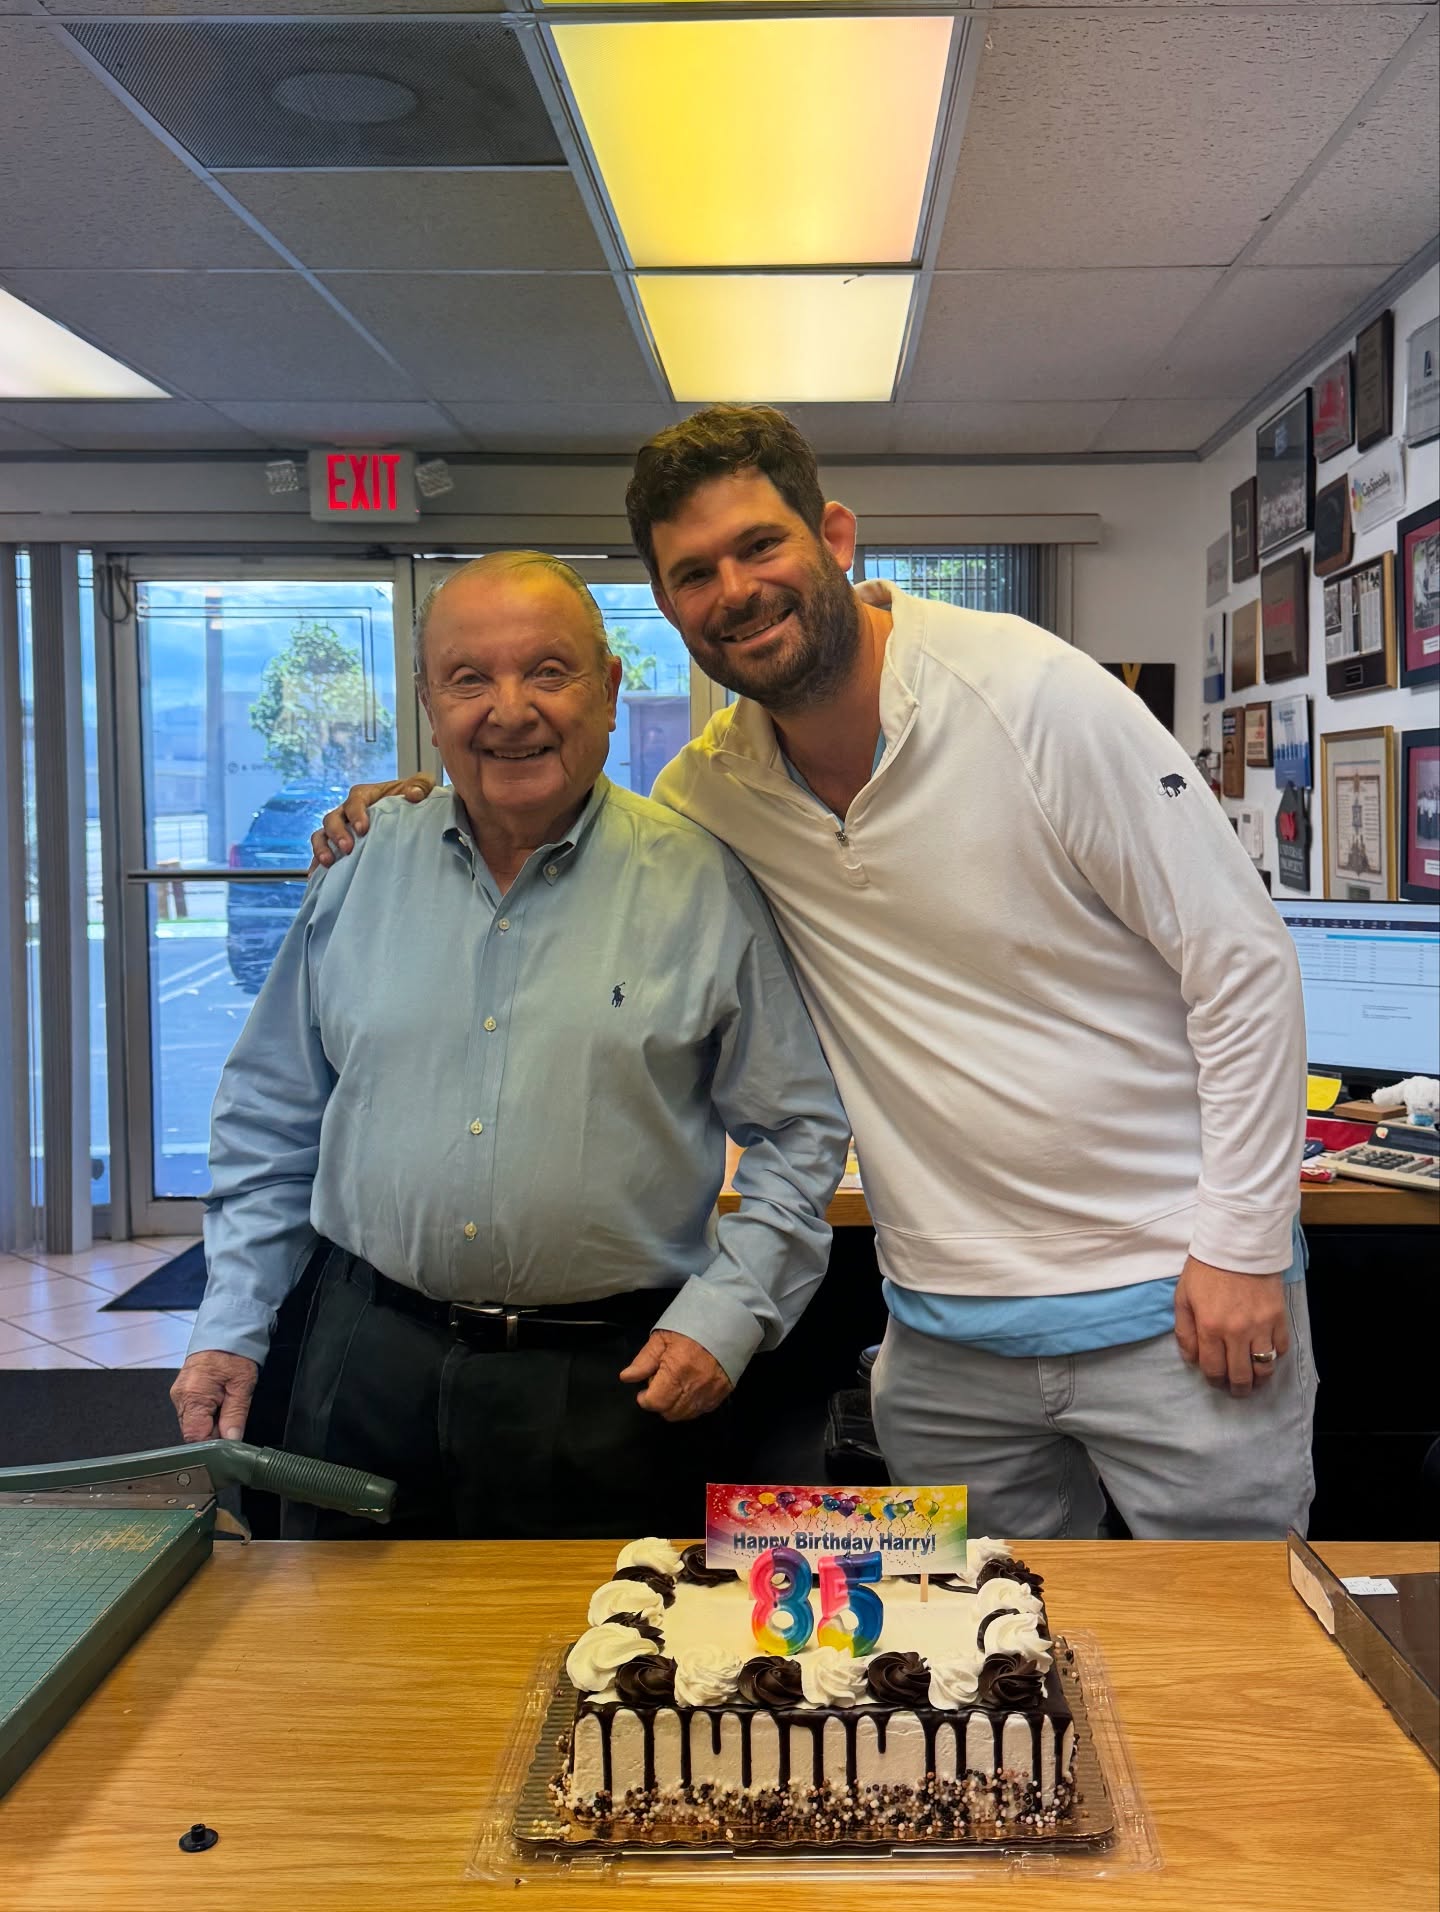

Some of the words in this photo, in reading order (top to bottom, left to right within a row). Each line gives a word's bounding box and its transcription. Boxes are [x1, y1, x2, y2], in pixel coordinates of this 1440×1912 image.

[327, 455, 400, 510] EXIT
[795, 1531, 874, 1553] Birthday
[879, 1532, 936, 1555] Harry!
[749, 1546, 884, 1658] 85
